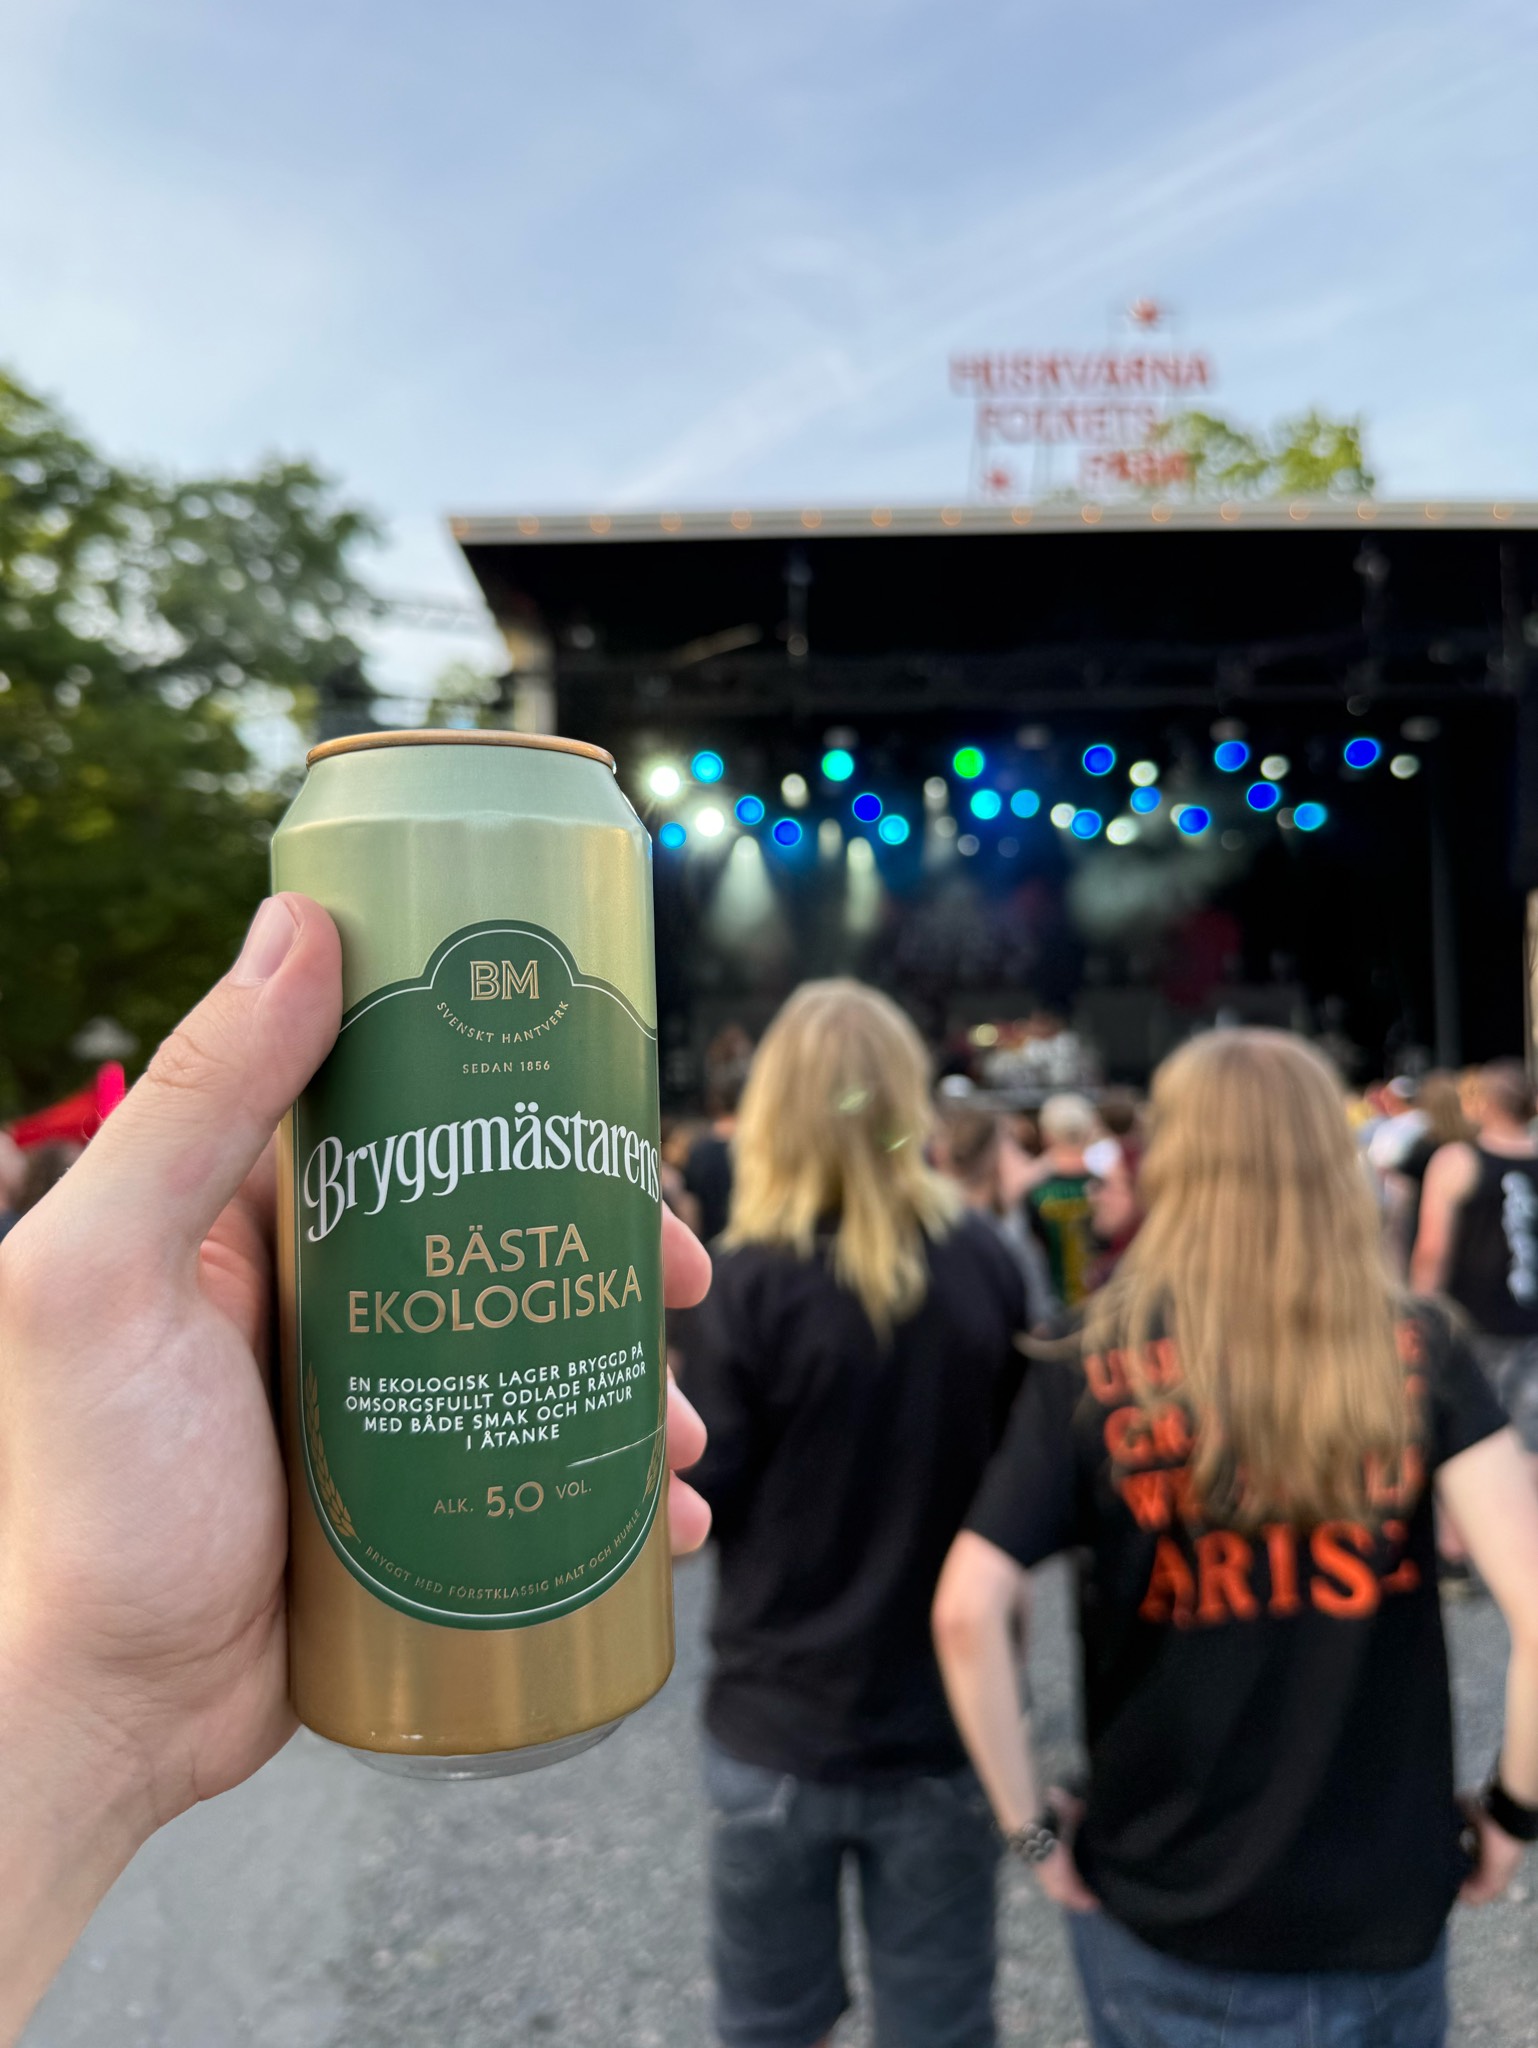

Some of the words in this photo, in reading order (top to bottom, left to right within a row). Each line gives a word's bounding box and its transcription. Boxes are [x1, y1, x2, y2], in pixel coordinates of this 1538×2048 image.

[470, 960, 540, 1001] BM
[436, 1001, 495, 1043] SVENSKT
[502, 1000, 569, 1044] HANTVERK
[462, 1062, 513, 1074] SEDAN
[520, 1060, 551, 1072] 1856
[303, 1101, 661, 1243] Bryggmästarens
[425, 1223, 590, 1278] BÄSTA
[348, 1265, 643, 1334] EKOLOGISKA
[346, 1393, 495, 1413] OMSORGSFULLT
[502, 1380, 581, 1406] ODLADE
[587, 1361, 646, 1393] RÅVAROR
[349, 1376, 371, 1392] EN
[379, 1373, 490, 1393] EKOLOGISK
[499, 1364, 561, 1387] LAGER
[568, 1349, 627, 1377] BRYGGD
[631, 1340, 644, 1361] PÅ
[364, 1416, 403, 1433] MED
[411, 1414, 464, 1433] BÅDE
[473, 1408, 528, 1430] SMAK
[537, 1400, 578, 1421] OCH
[585, 1385, 633, 1413] NATUR
[466, 1434, 472, 1451] I
[480, 1423, 560, 1449] ÅTANKE
[433, 1498, 474, 1514] ALK.
[487, 1480, 545, 1520] 5,0
[556, 1479, 592, 1500] VOL.
[365, 1545, 412, 1582] BRYGGT
[415, 1576, 443, 1594] MED
[554, 1564, 586, 1588] MALT
[589, 1545, 612, 1569] OCH
[613, 1508, 641, 1548] HUMLE
